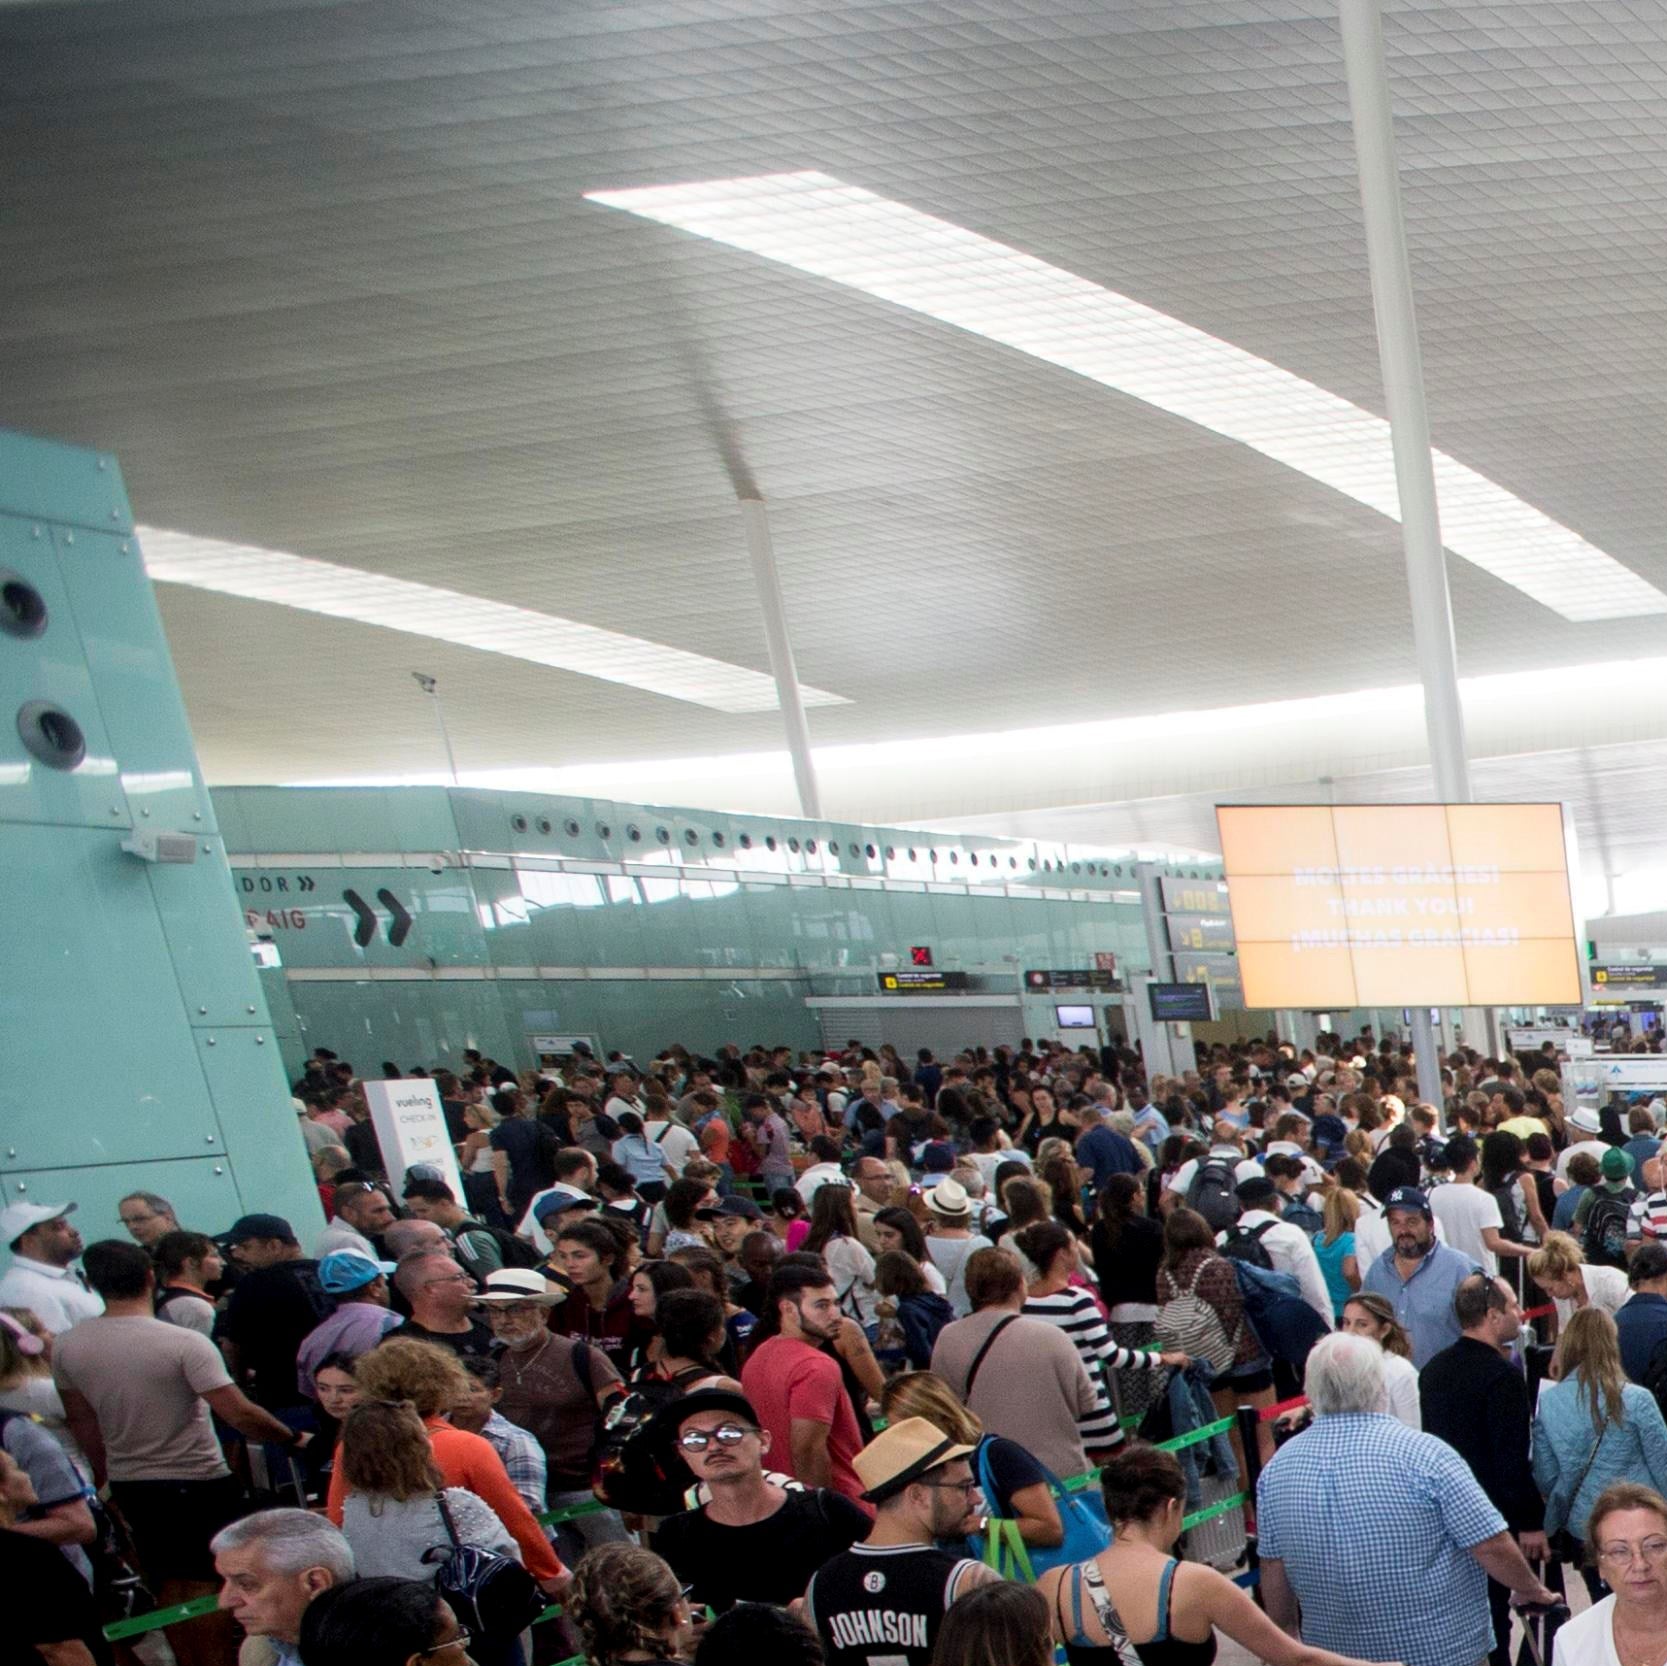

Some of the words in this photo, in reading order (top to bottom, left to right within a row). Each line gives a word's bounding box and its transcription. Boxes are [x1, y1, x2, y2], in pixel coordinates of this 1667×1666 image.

[236, 877, 289, 892] DOR
[1328, 898, 1408, 915] THANK
[396, 1095, 432, 1109] vueling
[829, 1609, 928, 1649] JOHNSON
